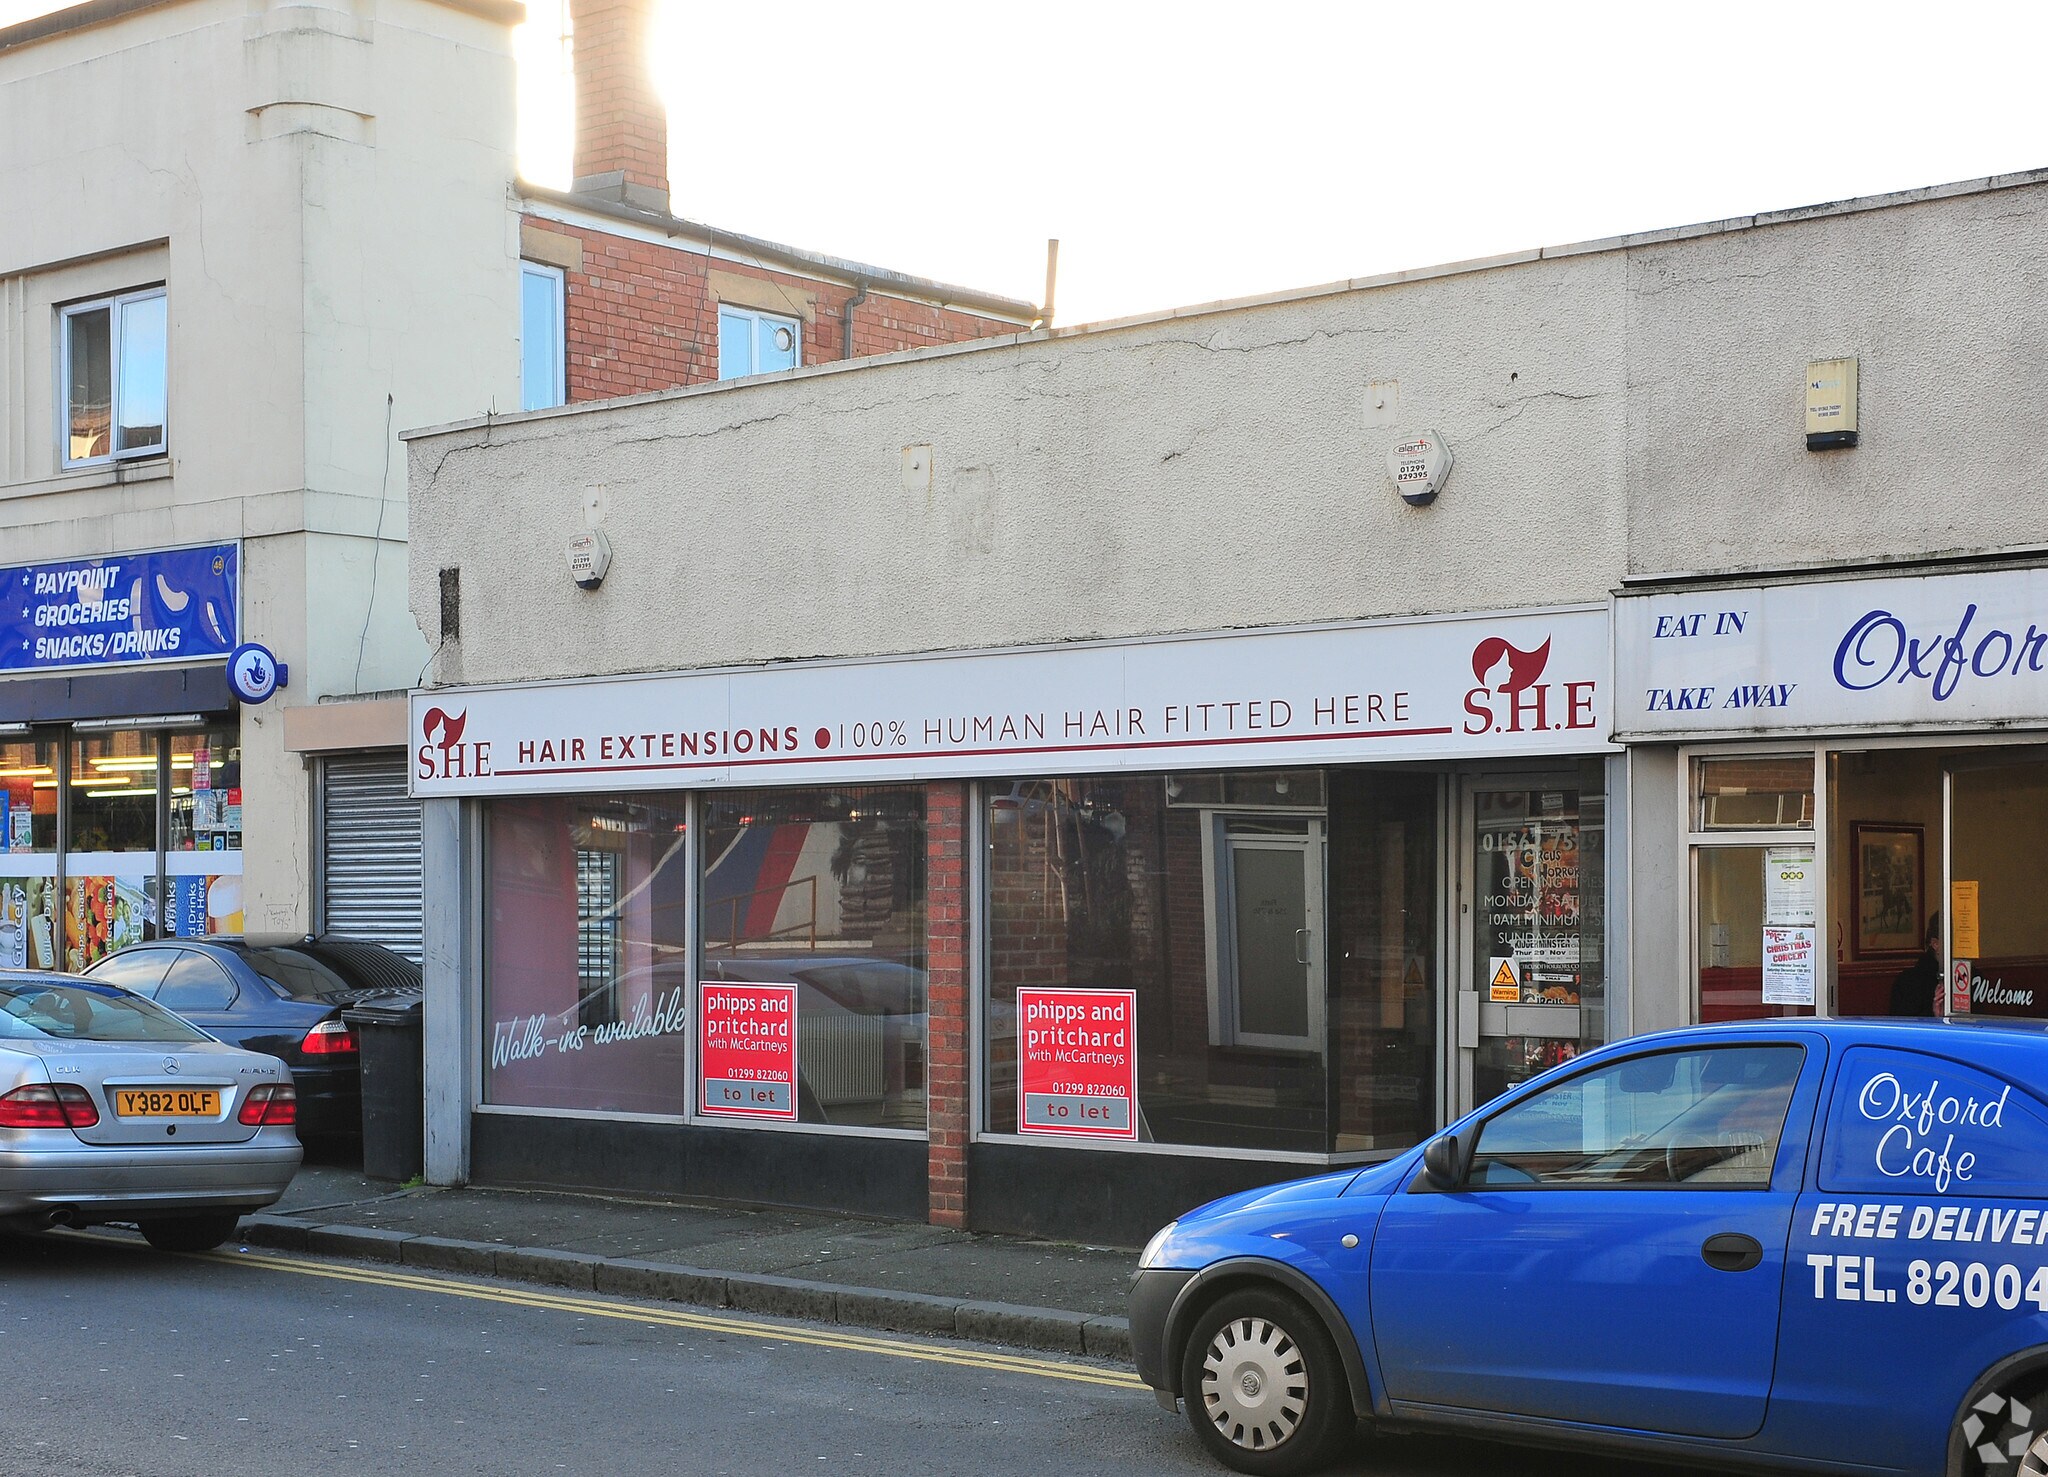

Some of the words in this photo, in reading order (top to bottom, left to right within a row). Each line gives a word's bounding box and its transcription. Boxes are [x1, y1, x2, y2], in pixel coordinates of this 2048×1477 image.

[1398, 471, 1428, 481] 829395
[1400, 464, 1426, 473] 01299
[34, 565, 120, 595] PAYPOINT
[34, 598, 130, 627] GROCERIES
[1653, 613, 1706, 639] EAT
[1713, 611, 1749, 636] IN
[34, 627, 181, 660] SNACKS/DRINKS
[1645, 687, 1715, 712] TAKE
[1722, 683, 1797, 710] AWAY
[839, 719, 907, 749] 100%
[924, 712, 1046, 745] HUMAN
[1064, 708, 1146, 738] HAIR
[1165, 700, 1293, 734] FITTED
[1314, 691, 1410, 726] HERE
[518, 738, 586, 764] HAIR
[600, 725, 799, 761] EXTENSIONS
[197, 877, 206, 909] Here
[1502, 876, 1564, 888] OPENING
[77, 879, 85, 919] Snacks
[188, 882, 197, 924] Drinks
[1484, 894, 1543, 907] MONDAY
[12, 887, 26, 966] Grocery
[106, 880, 115, 956] nfectionery
[1766, 940, 1812, 954] CHRISTMAS
[1773, 950, 1808, 963] CONCERT
[707, 992, 756, 1015] phipps
[760, 995, 788, 1013] and
[1972, 976, 2034, 1006] Welcome
[1027, 999, 1086, 1024] phipps
[1091, 1001, 1124, 1021] and
[491, 1013, 587, 1070] Walk-ins
[594, 986, 686, 1046] available
[707, 1016, 788, 1037] pritchard
[1028, 1025, 1125, 1049] pritchard
[708, 1037, 727, 1050] with
[730, 1037, 788, 1054] McCartneys
[1028, 1048, 1052, 1062] with
[1055, 1049, 1125, 1068] McCartneys
[55, 1066, 81, 1074] CLK
[728, 1067, 754, 1079] 01299
[756, 1069, 788, 1081] 822060
[723, 1087, 741, 1101] to
[750, 1087, 775, 1103] let
[1052, 1081, 1084, 1095] 01299
[1086, 1083, 1126, 1097] 822060
[124, 1092, 173, 1113] Y382
[1047, 1103, 1069, 1117] to
[1080, 1103, 1110, 1119] let
[1858, 1072, 2012, 1136] Oxford
[1875, 1124, 1976, 1193] Cafe
[1810, 1203, 1904, 1239] FREE
[1807, 1254, 1897, 1303] TEL.
[1906, 1259, 2048, 1312] 82004
